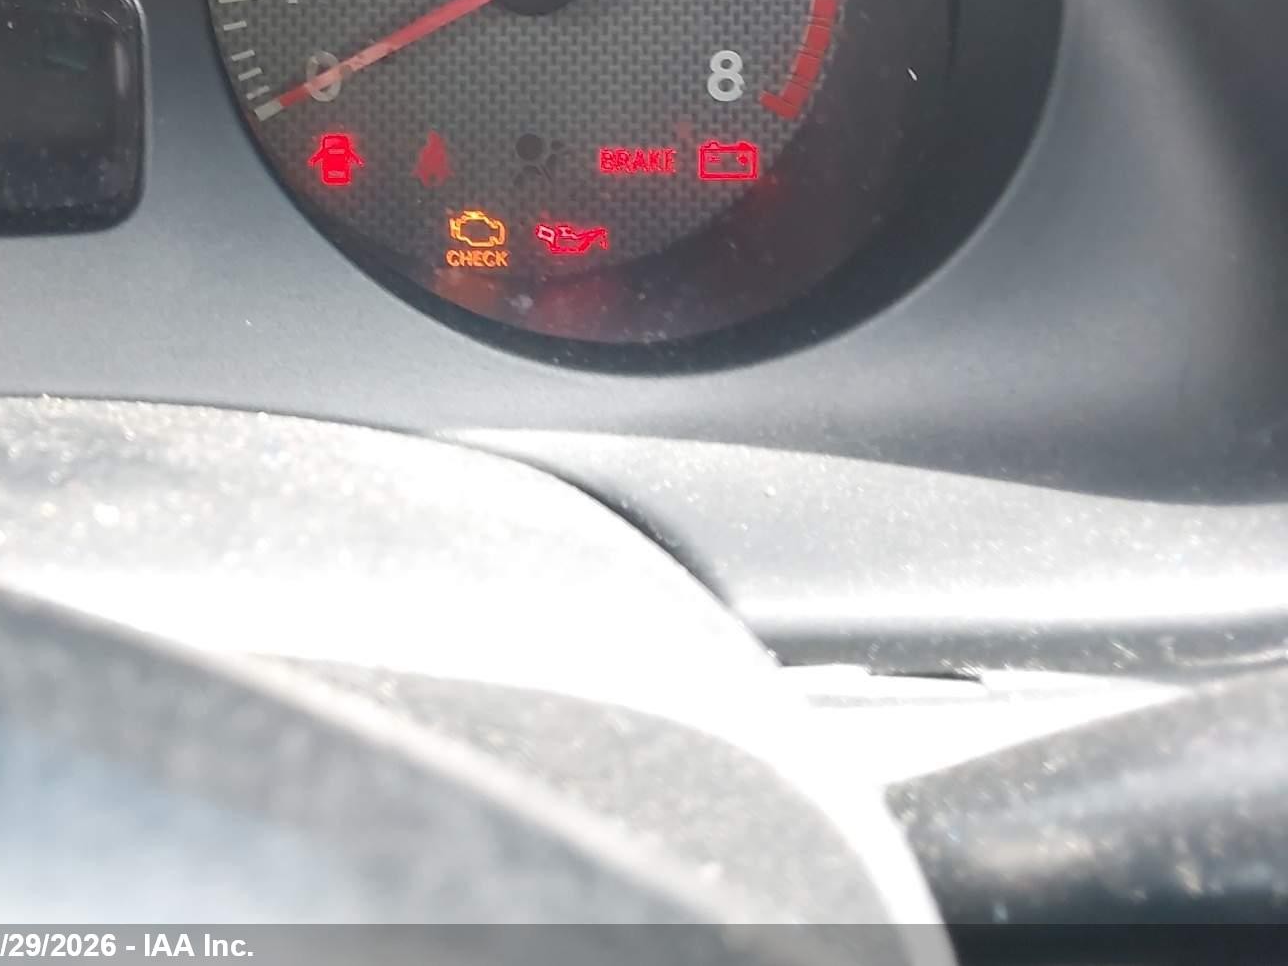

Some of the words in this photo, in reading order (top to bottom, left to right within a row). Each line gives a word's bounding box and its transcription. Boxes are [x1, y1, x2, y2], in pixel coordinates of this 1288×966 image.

[707, 49, 745, 102] 8
[599, 147, 678, 175] BRAKE
[446, 249, 510, 267] CHECK
